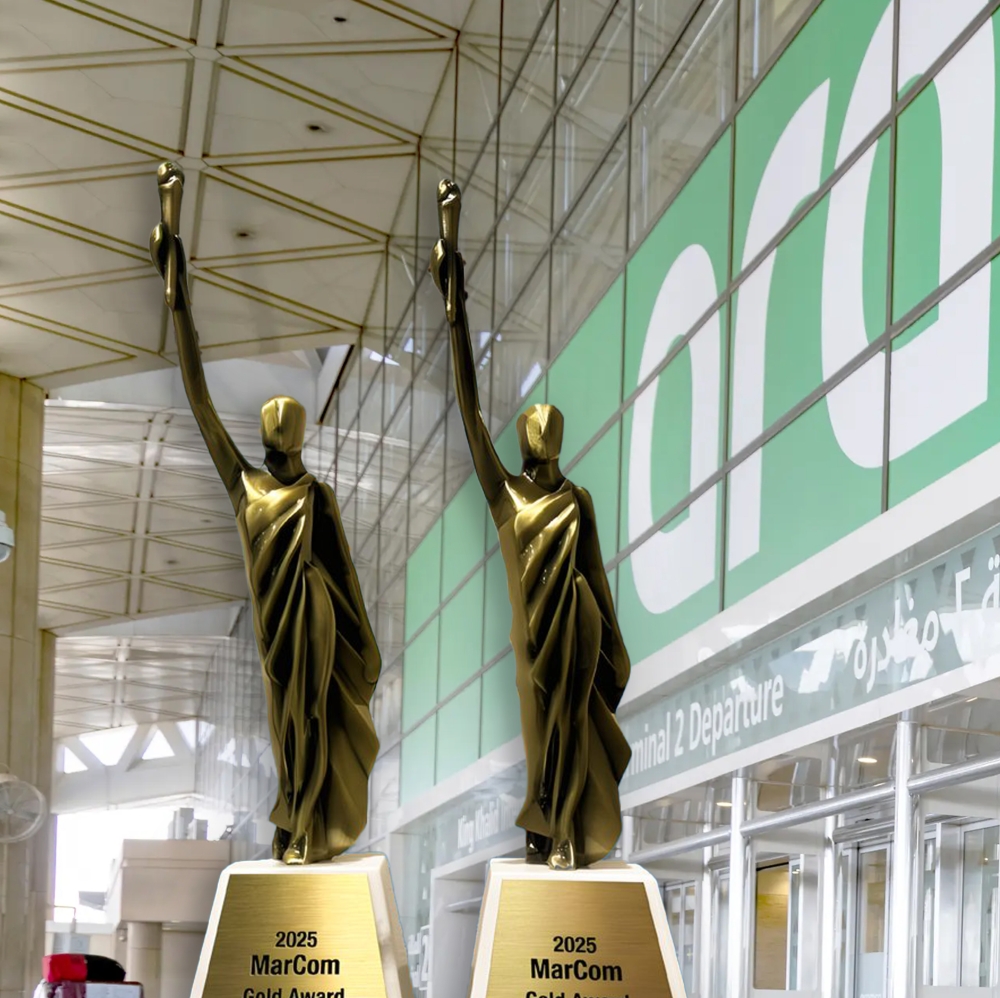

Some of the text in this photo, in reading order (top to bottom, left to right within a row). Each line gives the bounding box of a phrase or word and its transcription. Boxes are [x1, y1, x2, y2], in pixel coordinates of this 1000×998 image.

[674, 708, 685, 757] 2
[689, 674, 784, 756] Departure
[275, 931, 317, 948] 2025
[553, 936, 597, 953] 2025
[251, 954, 340, 976] MarCom
[530, 958, 622, 981] MarCom
